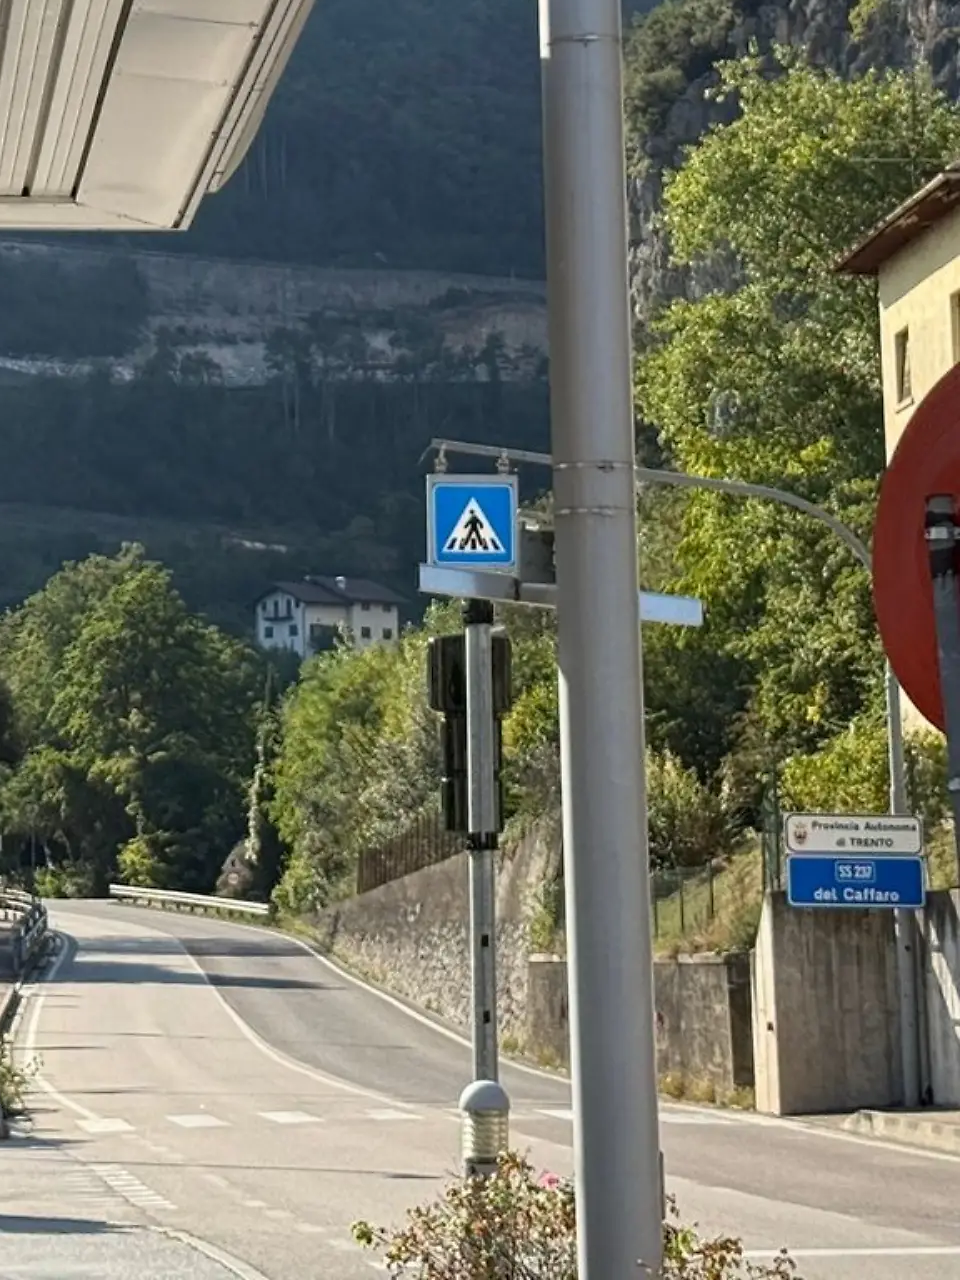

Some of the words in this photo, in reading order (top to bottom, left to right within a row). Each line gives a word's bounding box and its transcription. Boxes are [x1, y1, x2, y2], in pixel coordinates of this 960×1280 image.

[811, 821, 859, 830] Provincia
[864, 821, 917, 832] Autonoma
[849, 837, 894, 848] TRENTO
[839, 865, 852, 878] SS
[813, 887, 838, 901] del
[843, 887, 900, 901] Caffaro
